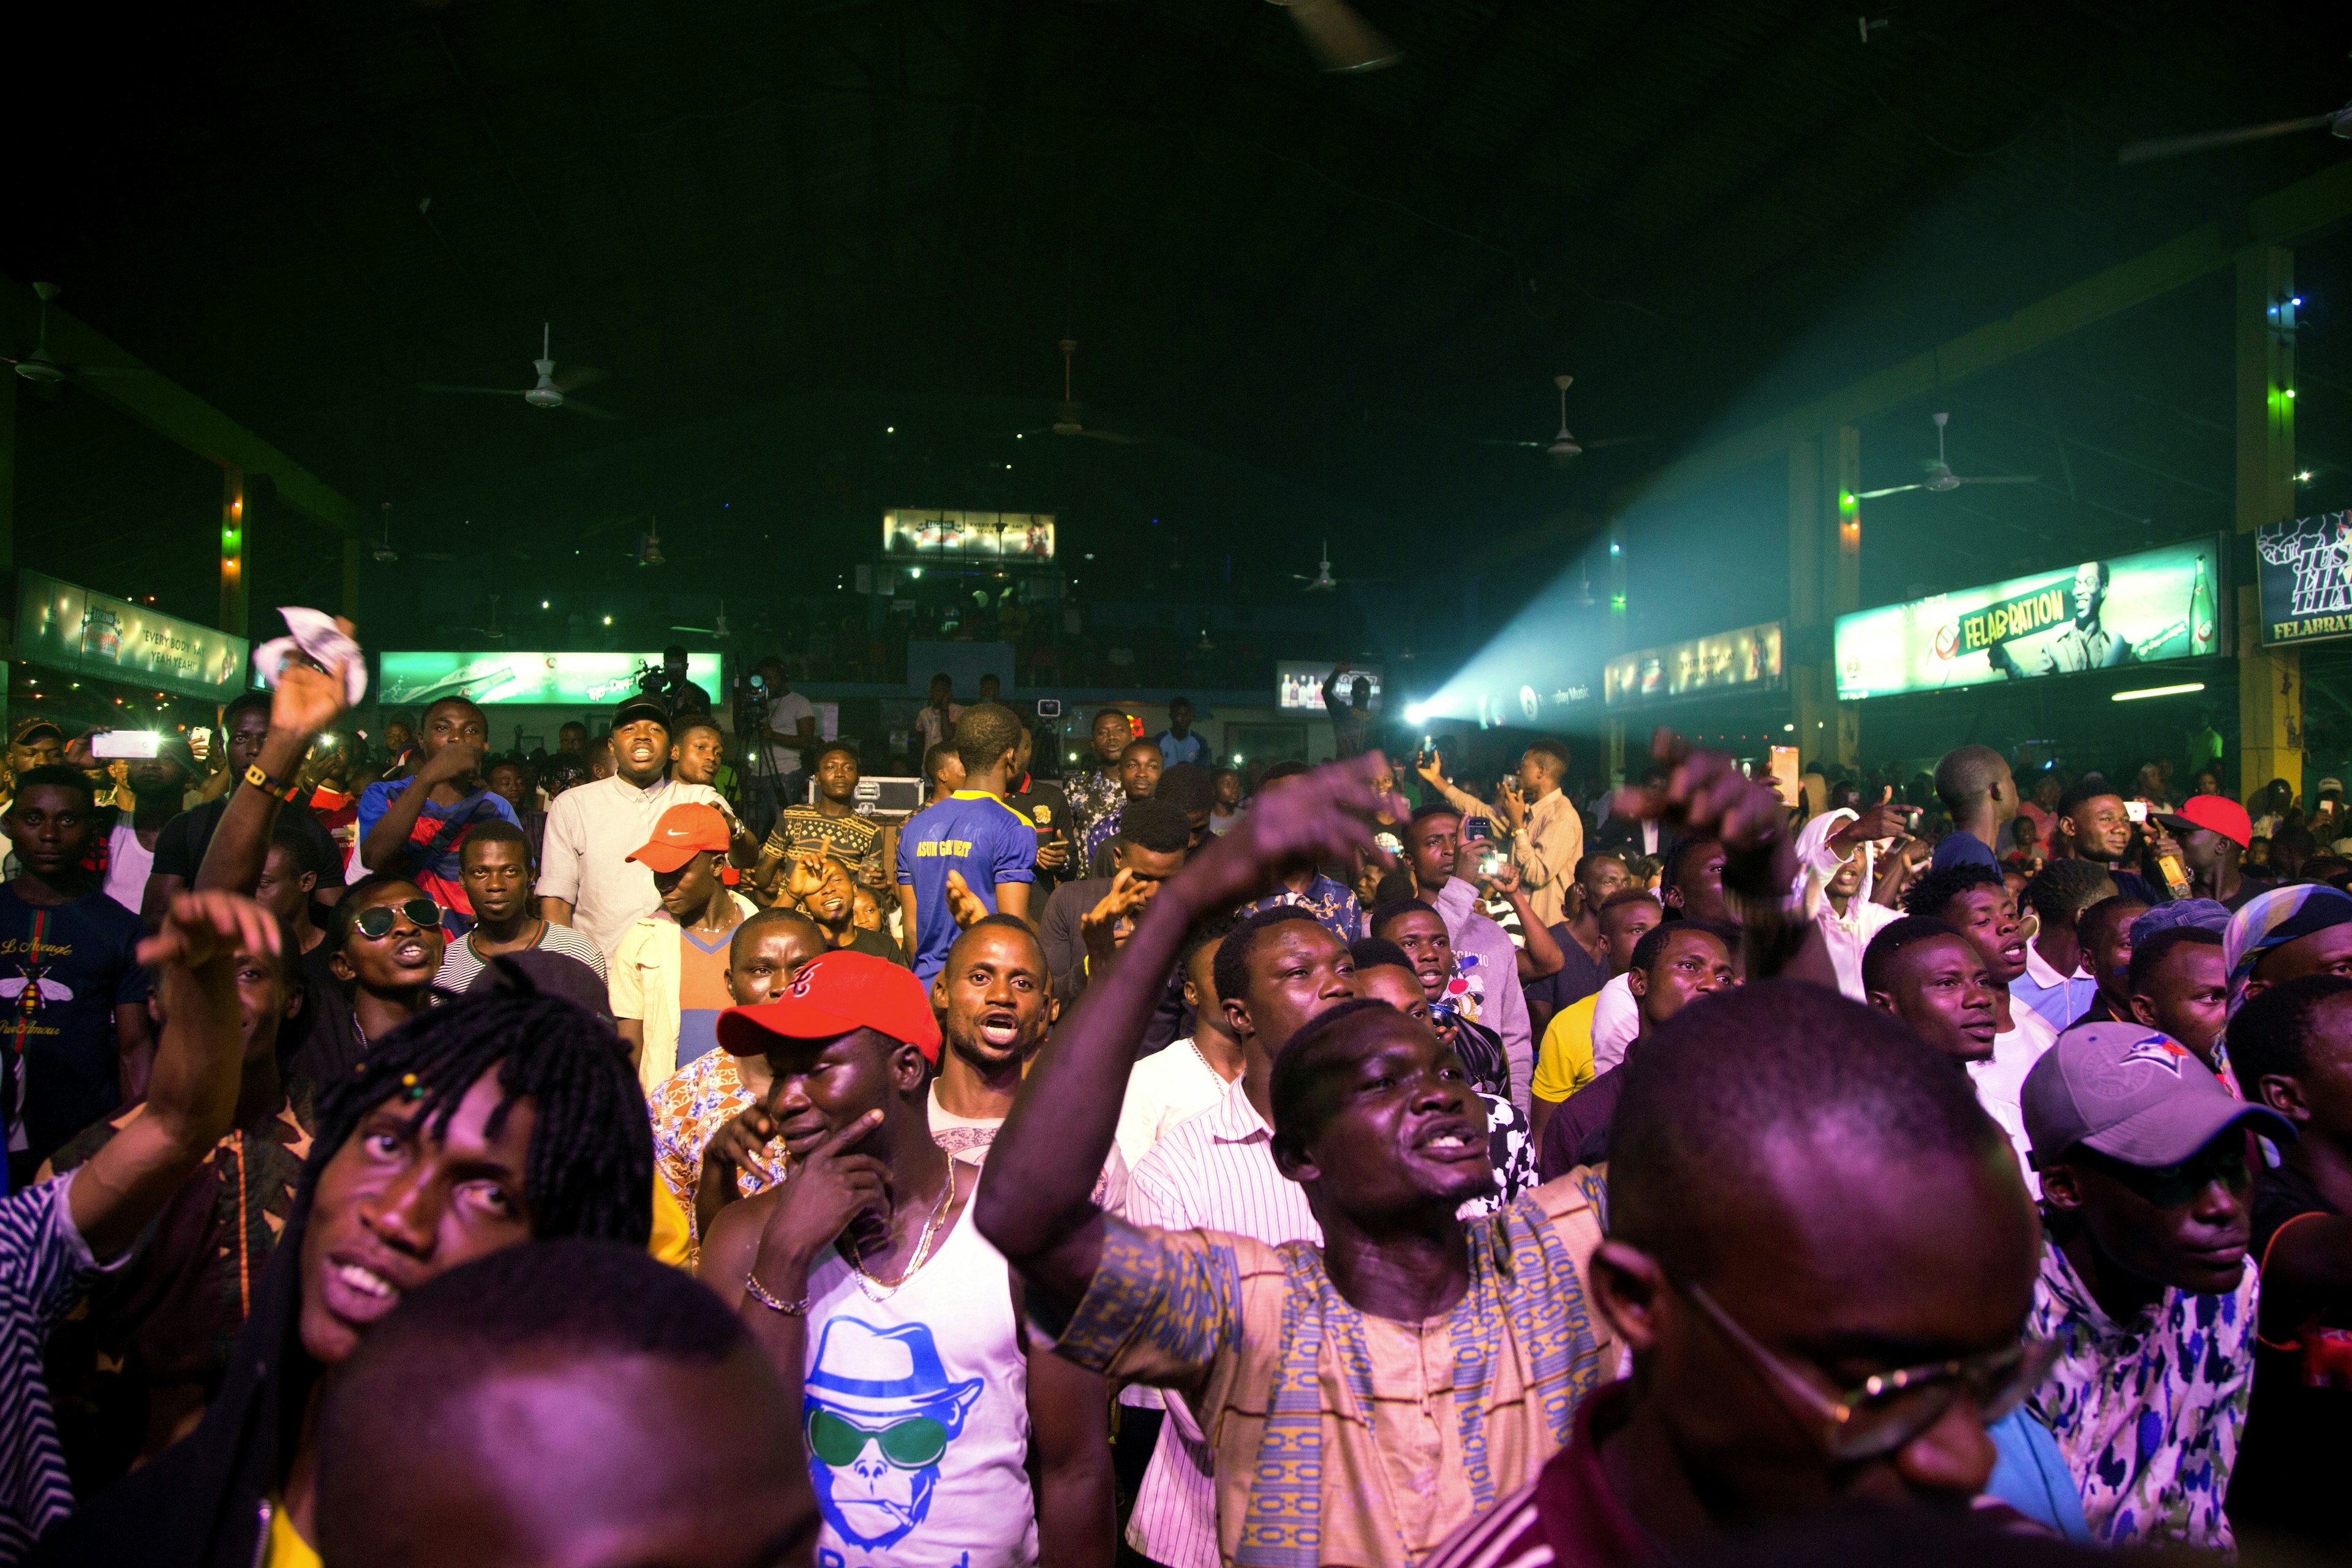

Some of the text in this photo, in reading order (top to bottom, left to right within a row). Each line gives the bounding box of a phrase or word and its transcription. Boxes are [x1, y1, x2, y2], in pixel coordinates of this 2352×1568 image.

[2293, 541, 2352, 574] JUS
[2295, 567, 2352, 593] LIK
[93, 609, 115, 624] LEGEND
[1964, 589, 2065, 650] FELABRATION
[170, 638, 190, 654] BODY
[193, 644, 206, 657] SAY
[151, 650, 172, 666] YEAH
[1569, 684, 1591, 701] Music
[916, 841, 938, 857] ASUN
